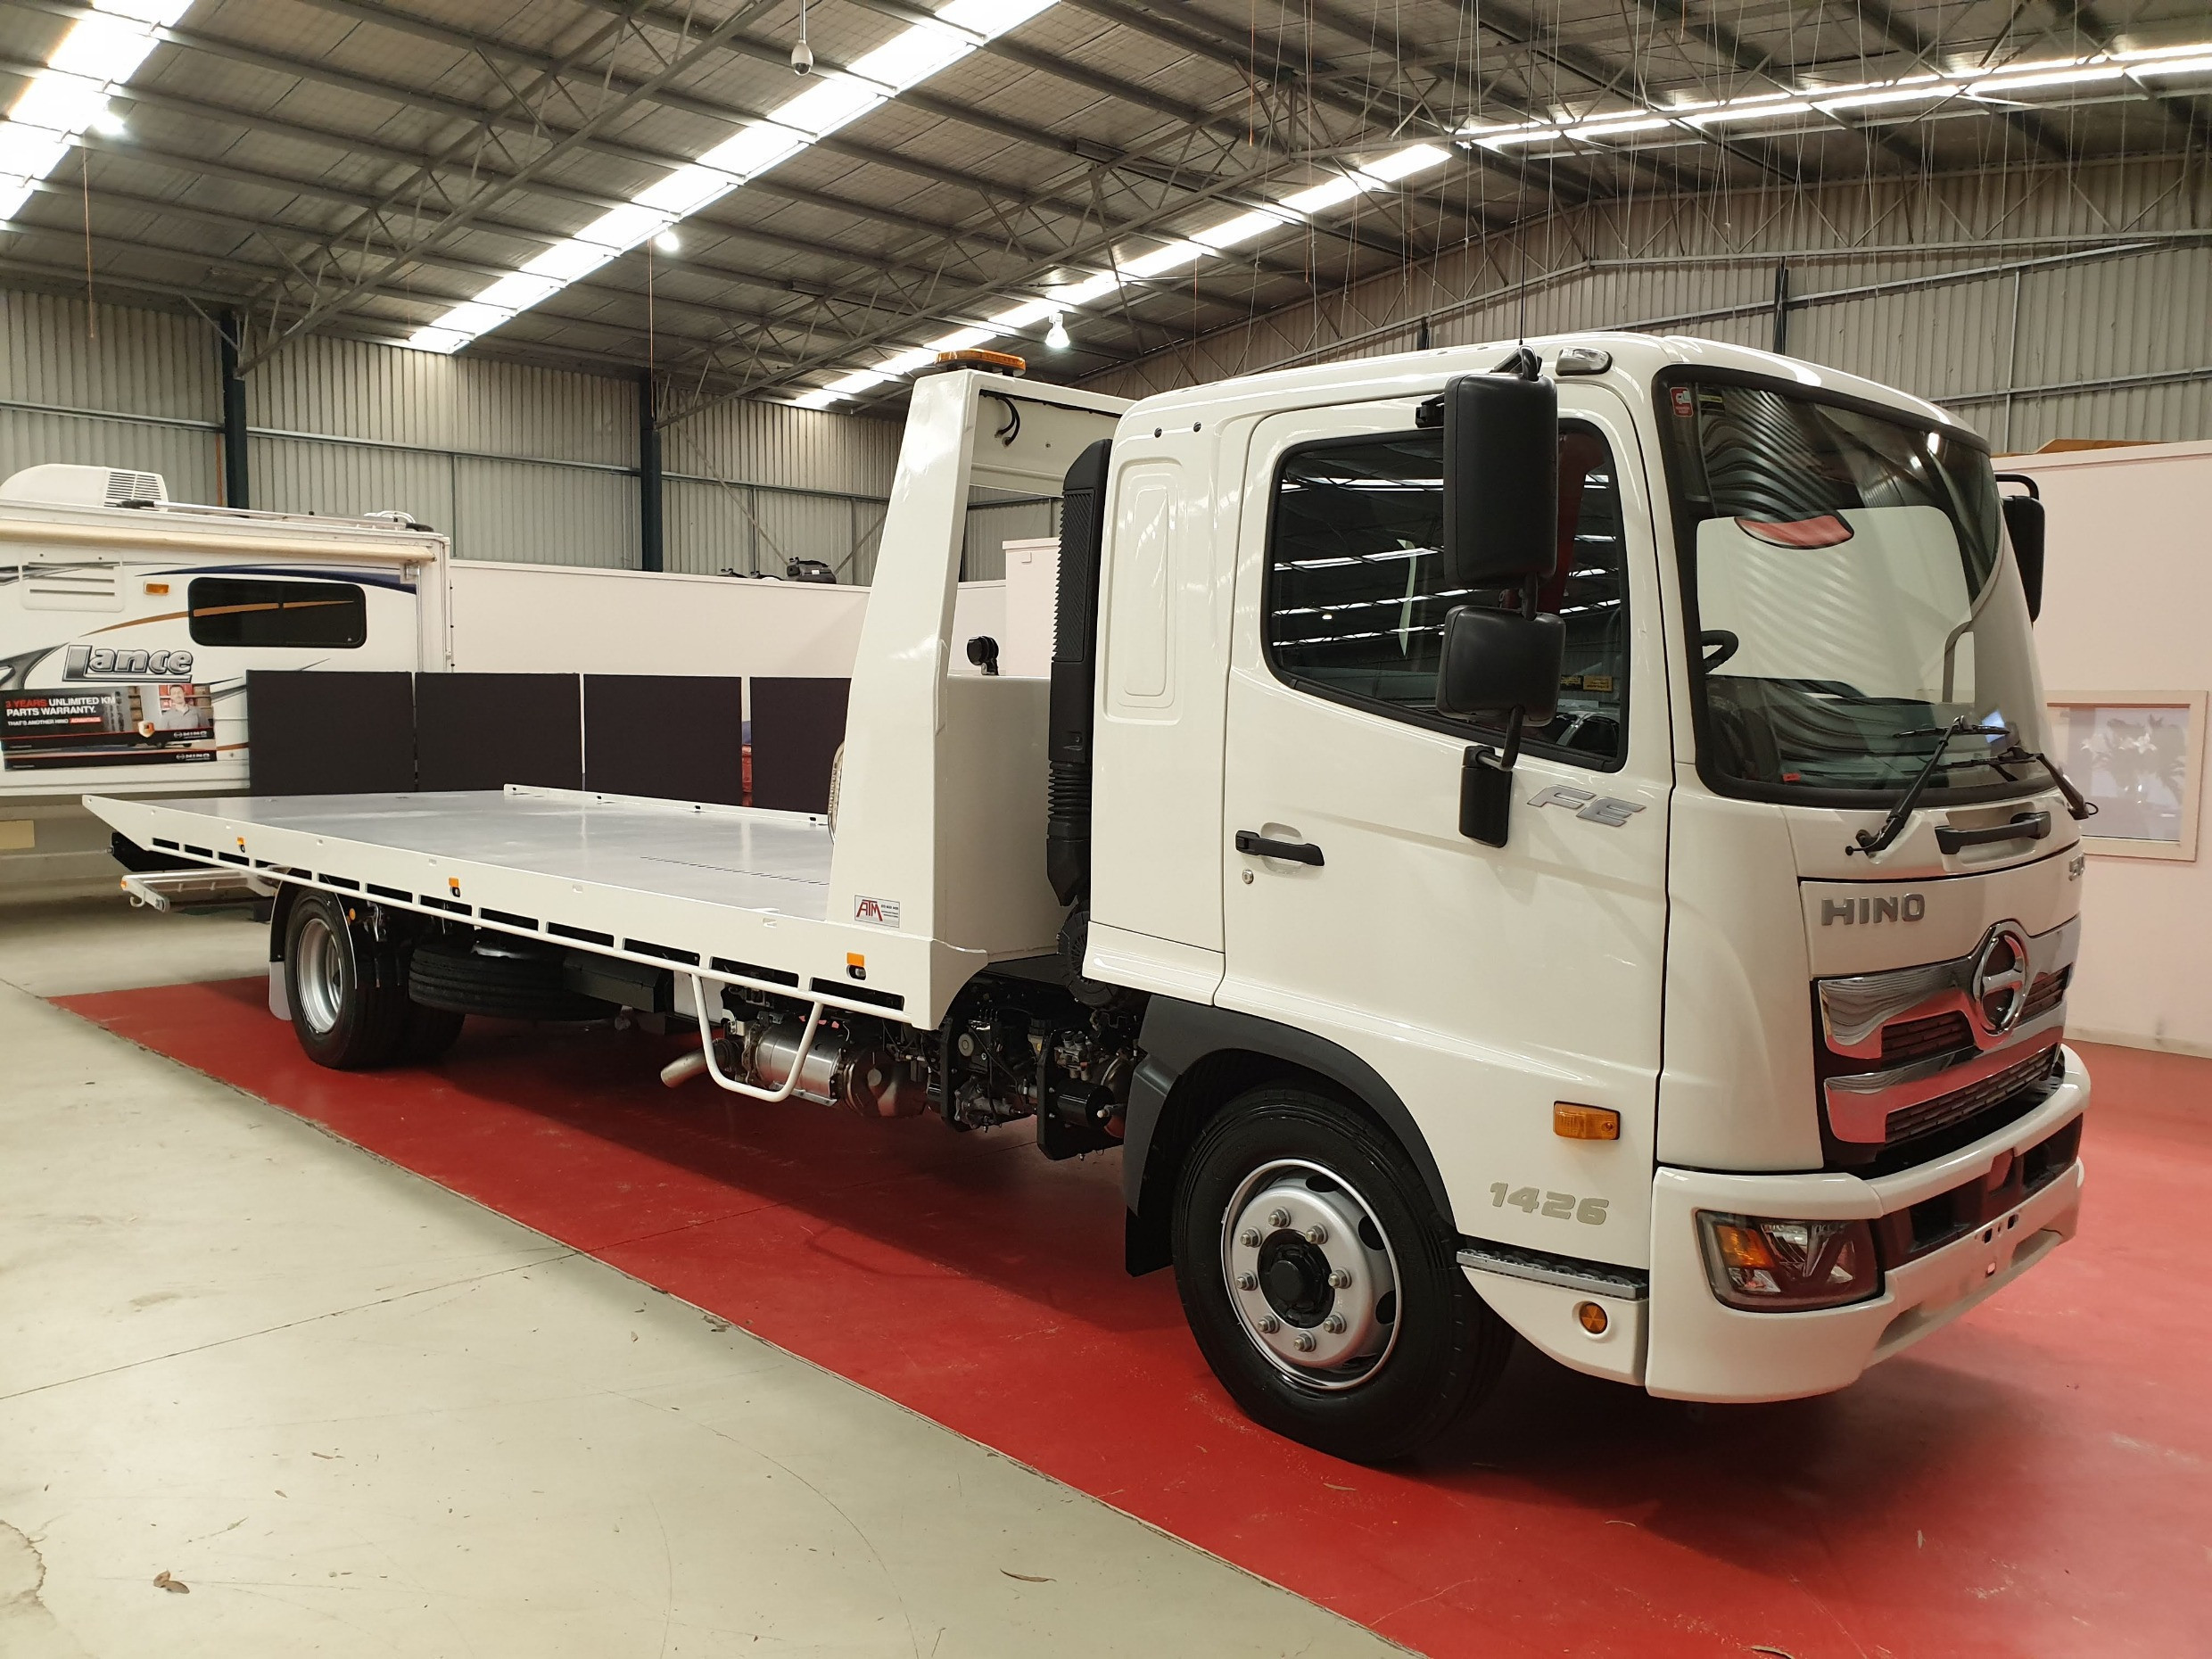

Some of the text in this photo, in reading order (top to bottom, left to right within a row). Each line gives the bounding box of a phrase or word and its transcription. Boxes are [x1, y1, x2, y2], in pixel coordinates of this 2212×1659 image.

[62, 644, 194, 683] Lance
[6, 706, 96, 716] PARTS WARRANTY.
[13, 699, 47, 707] YEARS
[48, 697, 100, 706] UNLIMITED
[101, 697, 116, 705] KM
[1527, 784, 1647, 828] FE
[856, 899, 883, 921] ATM
[1820, 893, 1925, 926] HINO
[1490, 1181, 1610, 1226] 1426
